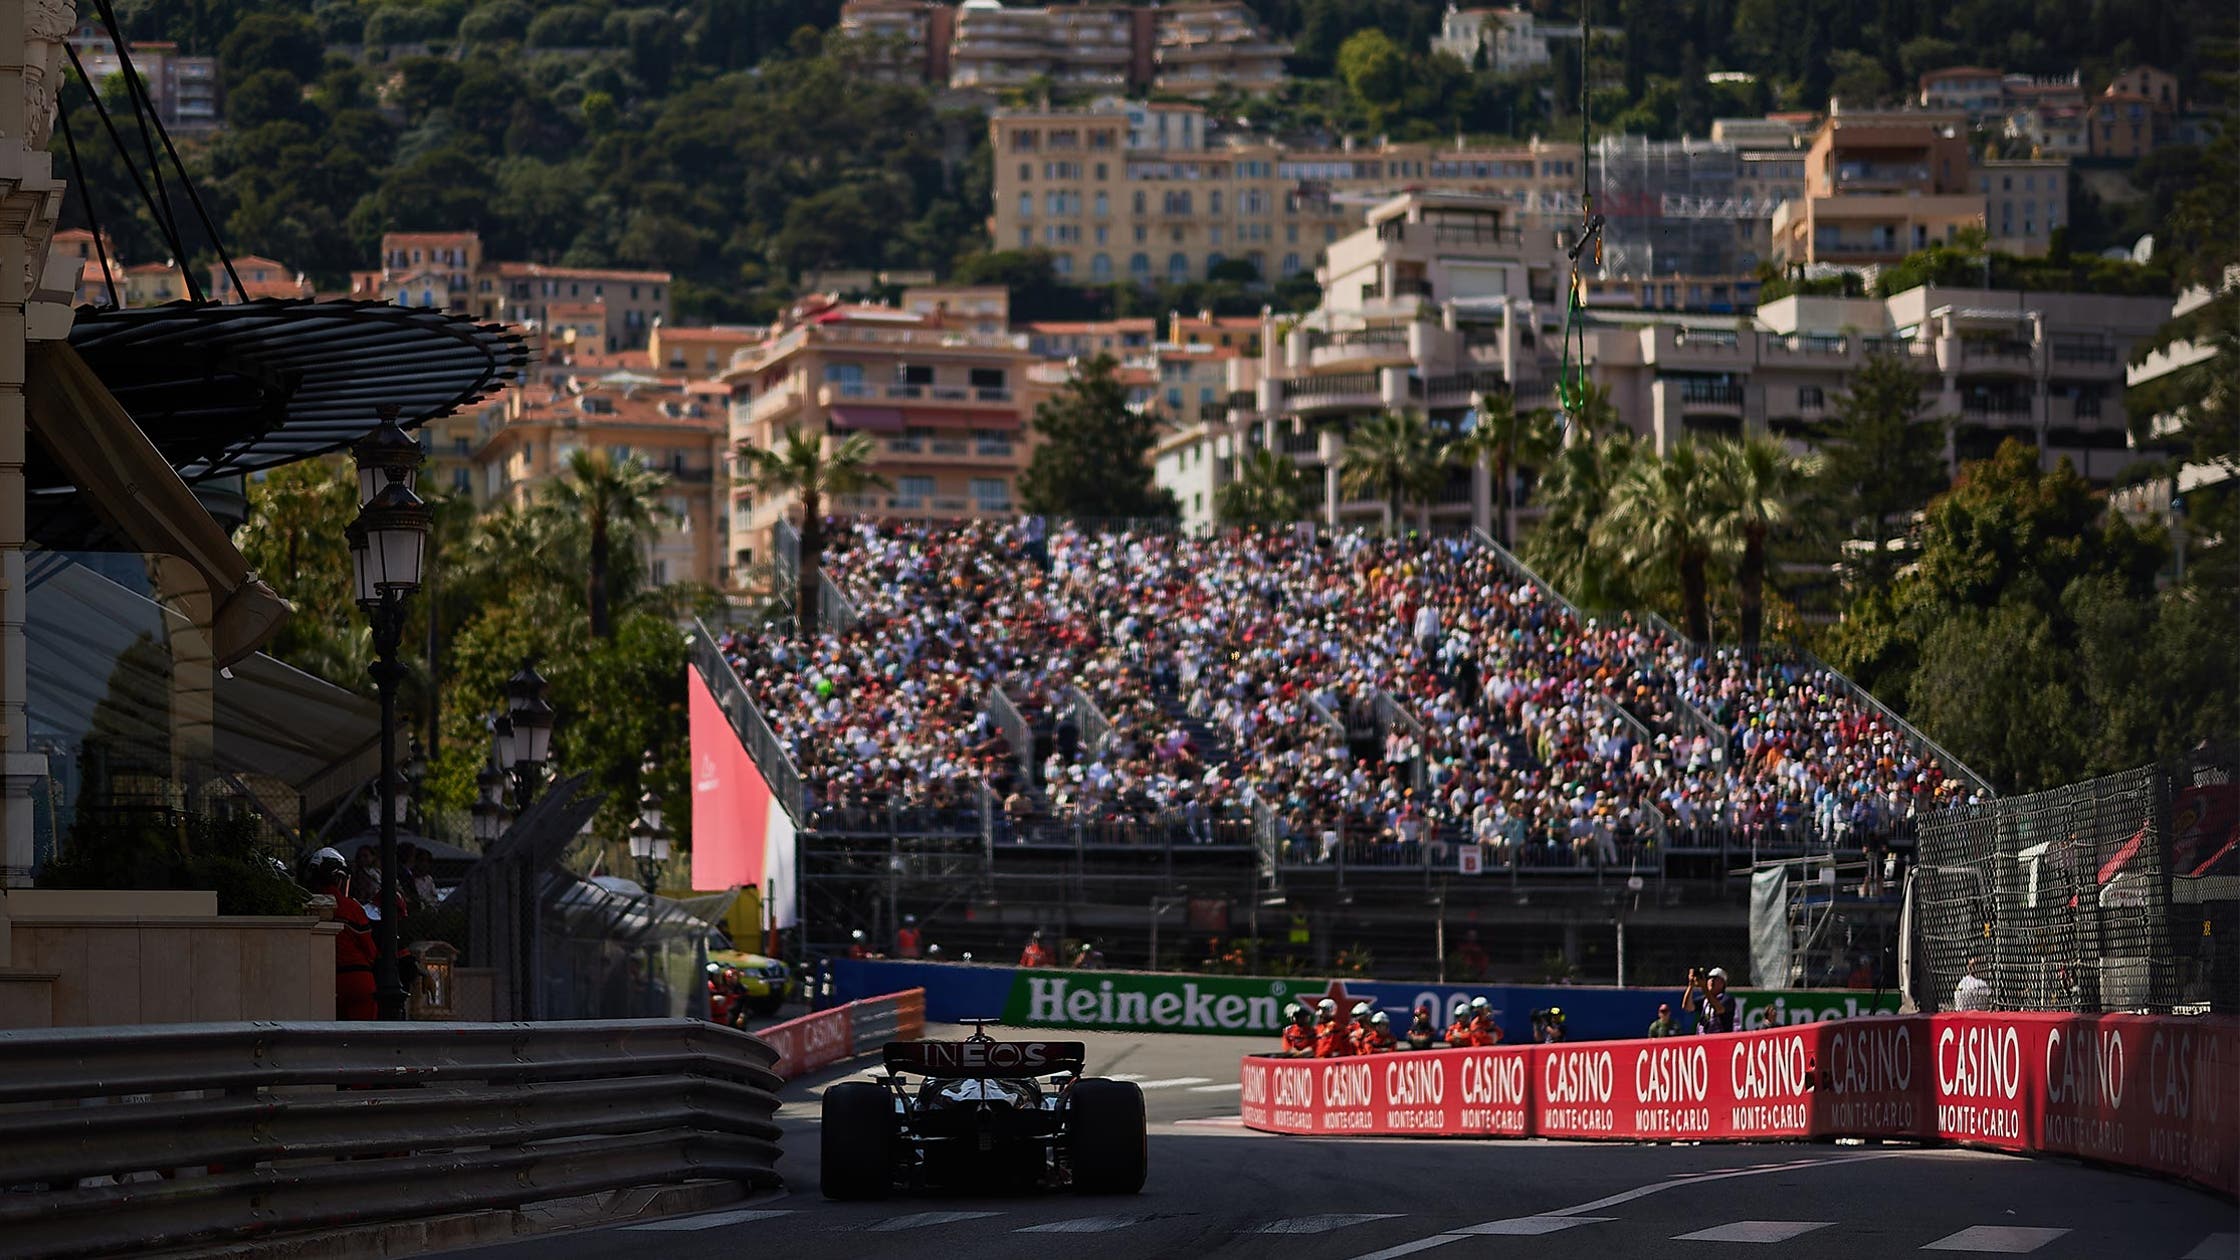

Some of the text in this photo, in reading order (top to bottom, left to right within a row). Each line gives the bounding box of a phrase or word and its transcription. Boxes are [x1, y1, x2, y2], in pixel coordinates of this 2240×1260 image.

[1027, 978, 1281, 1029] Heineken
[922, 1043, 1047, 1067] INEOS
[1386, 1058, 1444, 1105] CASINO
[1461, 1055, 1525, 1105] CASINO
[1545, 1050, 1613, 1103] CASINO
[1635, 1045, 1708, 1102] CASINO
[1731, 1035, 1805, 1100] CASINO
[1831, 1025, 1911, 1095] CASINO
[1938, 1026, 2020, 1100] CASINO
[2046, 1028, 2124, 1109] CASINO
[2151, 1030, 2220, 1124] CASNO
[1273, 1066, 1312, 1108] CASINO
[1322, 1063, 1372, 1107] CASINO
